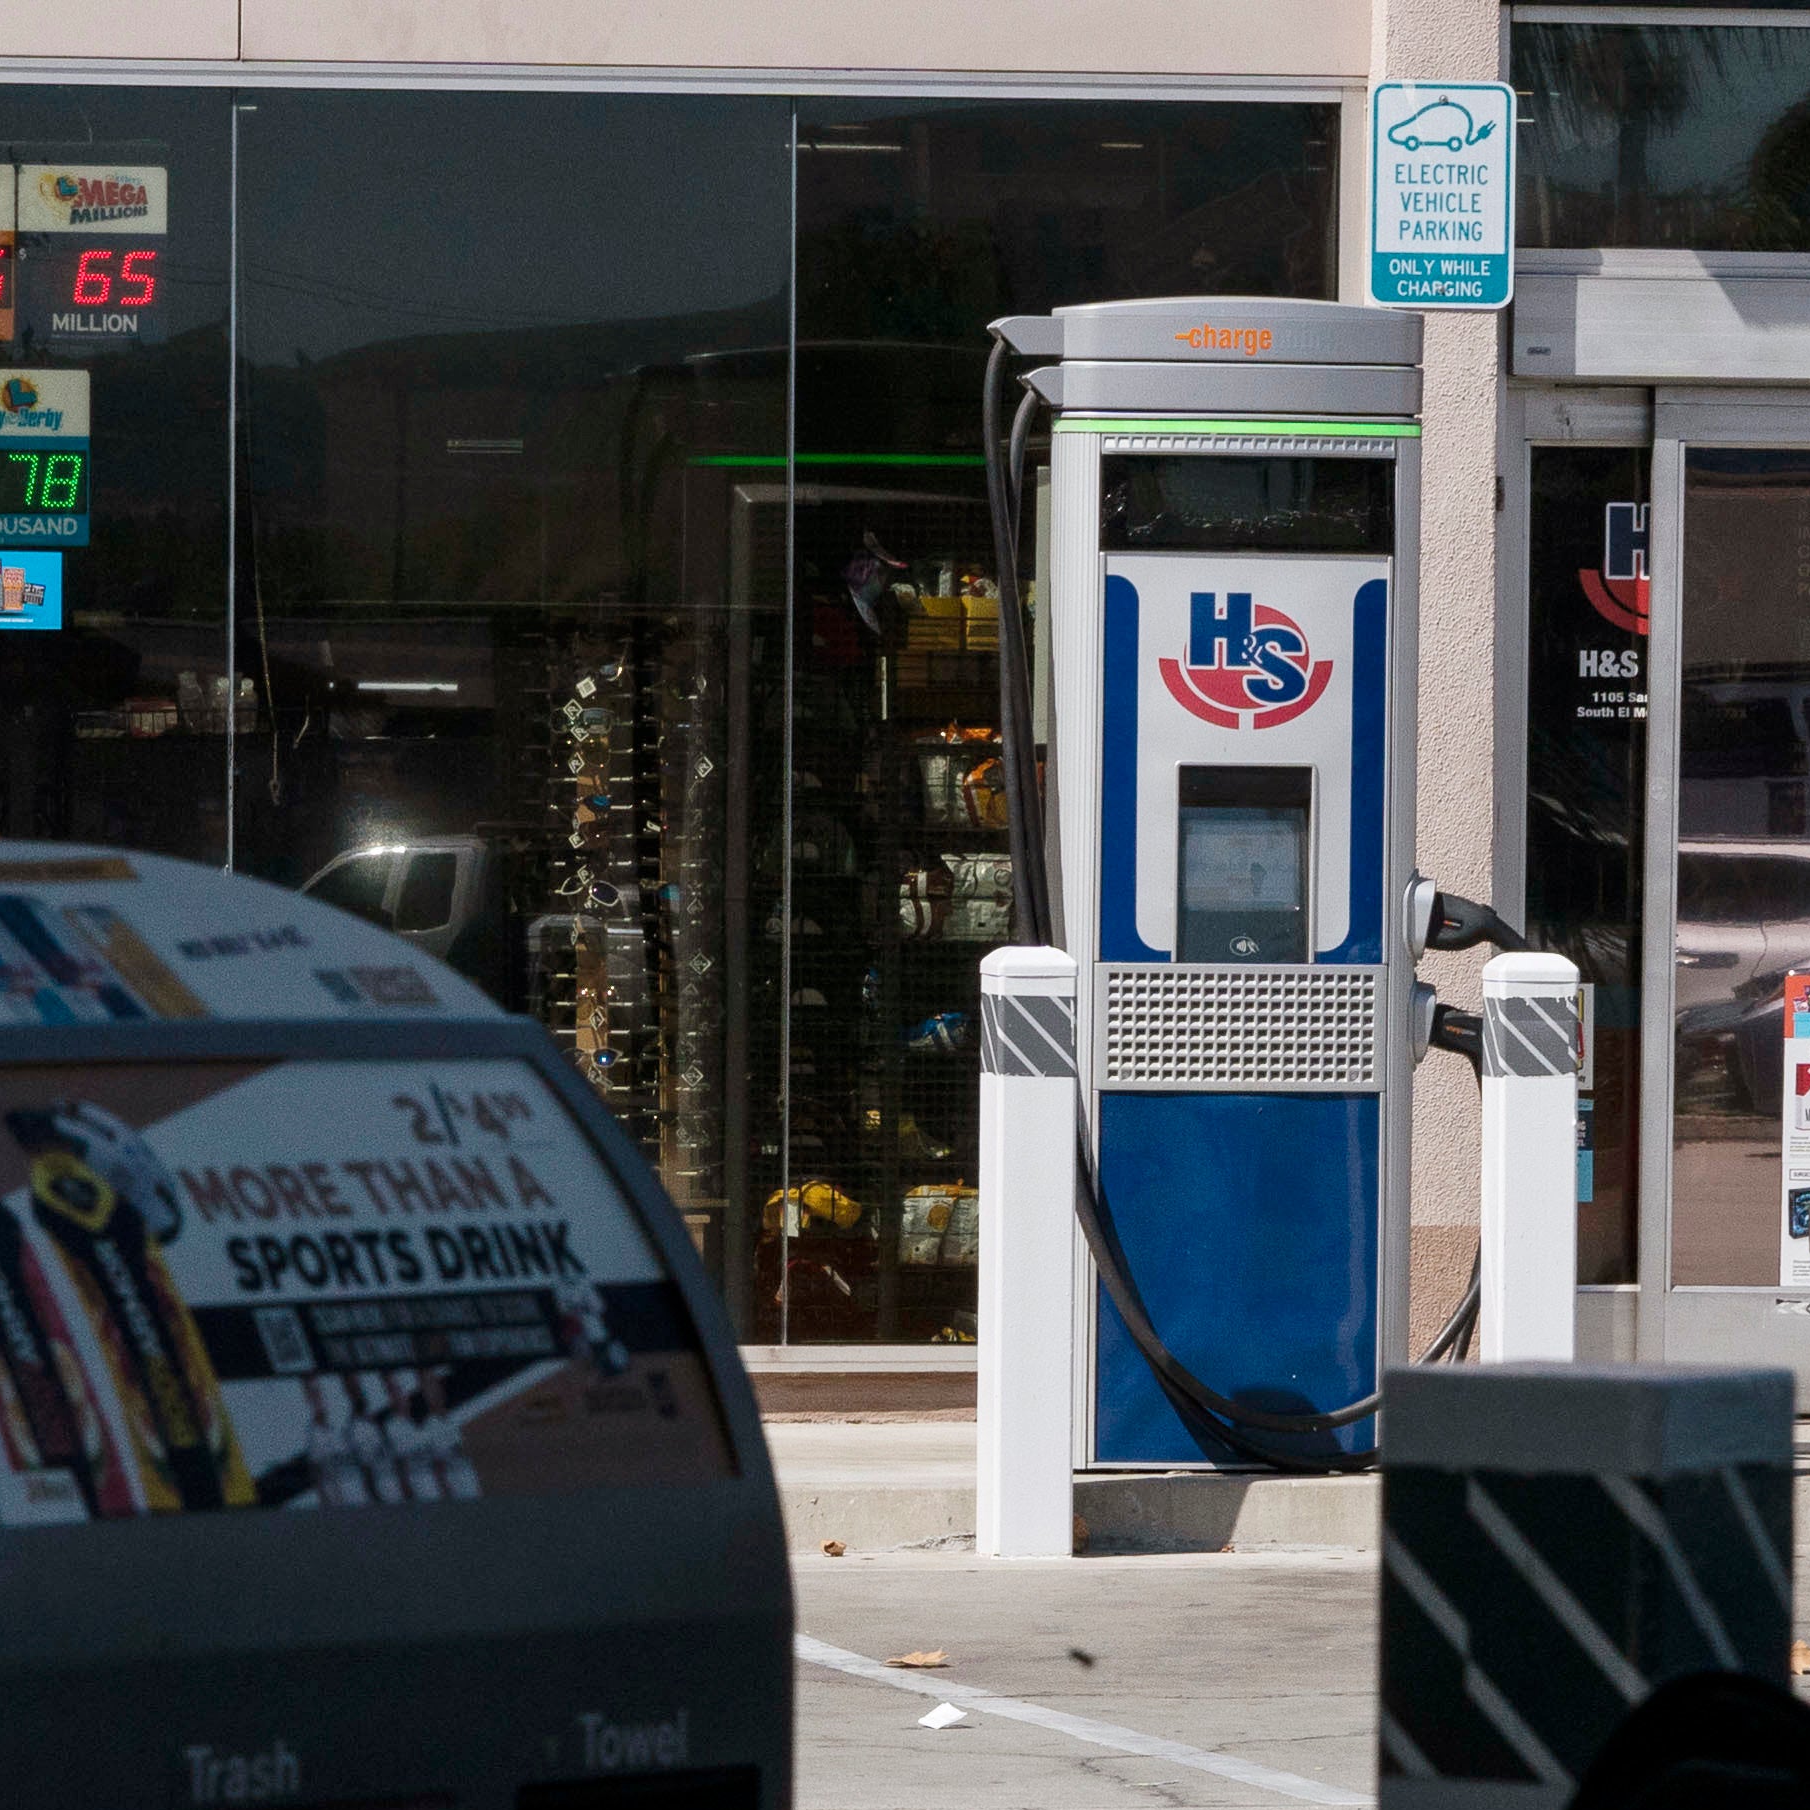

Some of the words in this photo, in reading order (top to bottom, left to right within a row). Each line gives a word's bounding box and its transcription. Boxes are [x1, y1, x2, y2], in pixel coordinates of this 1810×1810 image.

[1394, 163, 1489, 185] ELECTRIC
[77, 178, 148, 207] MEGA
[1400, 192, 1482, 213] VEHICLE
[70, 206, 148, 225] MILLIONS
[1399, 220, 1483, 242] PARKING
[72, 250, 157, 305] 65
[1389, 258, 1436, 276] ONLY
[1440, 259, 1491, 277] WHILE
[1396, 279, 1484, 297] CHARGING
[51, 313, 138, 333] MILLION
[1190, 323, 1272, 356] charge
[17, 408, 63, 431] Derby
[1190, 592, 1307, 704] H&S
[1578, 650, 1639, 678] H&S
[1591, 691, 1624, 704] 1105
[1576, 706, 1615, 718] South
[1617, 706, 1631, 718] El
[183, 1162, 337, 1224] MORE
[342, 1154, 502, 1216] THAN
[506, 1153, 556, 1207] A
[228, 1230, 423, 1293] SPORTS
[428, 1220, 587, 1280] DRINK
[577, 1708, 689, 1771] Towel
[184, 1738, 300, 1801] Trash
